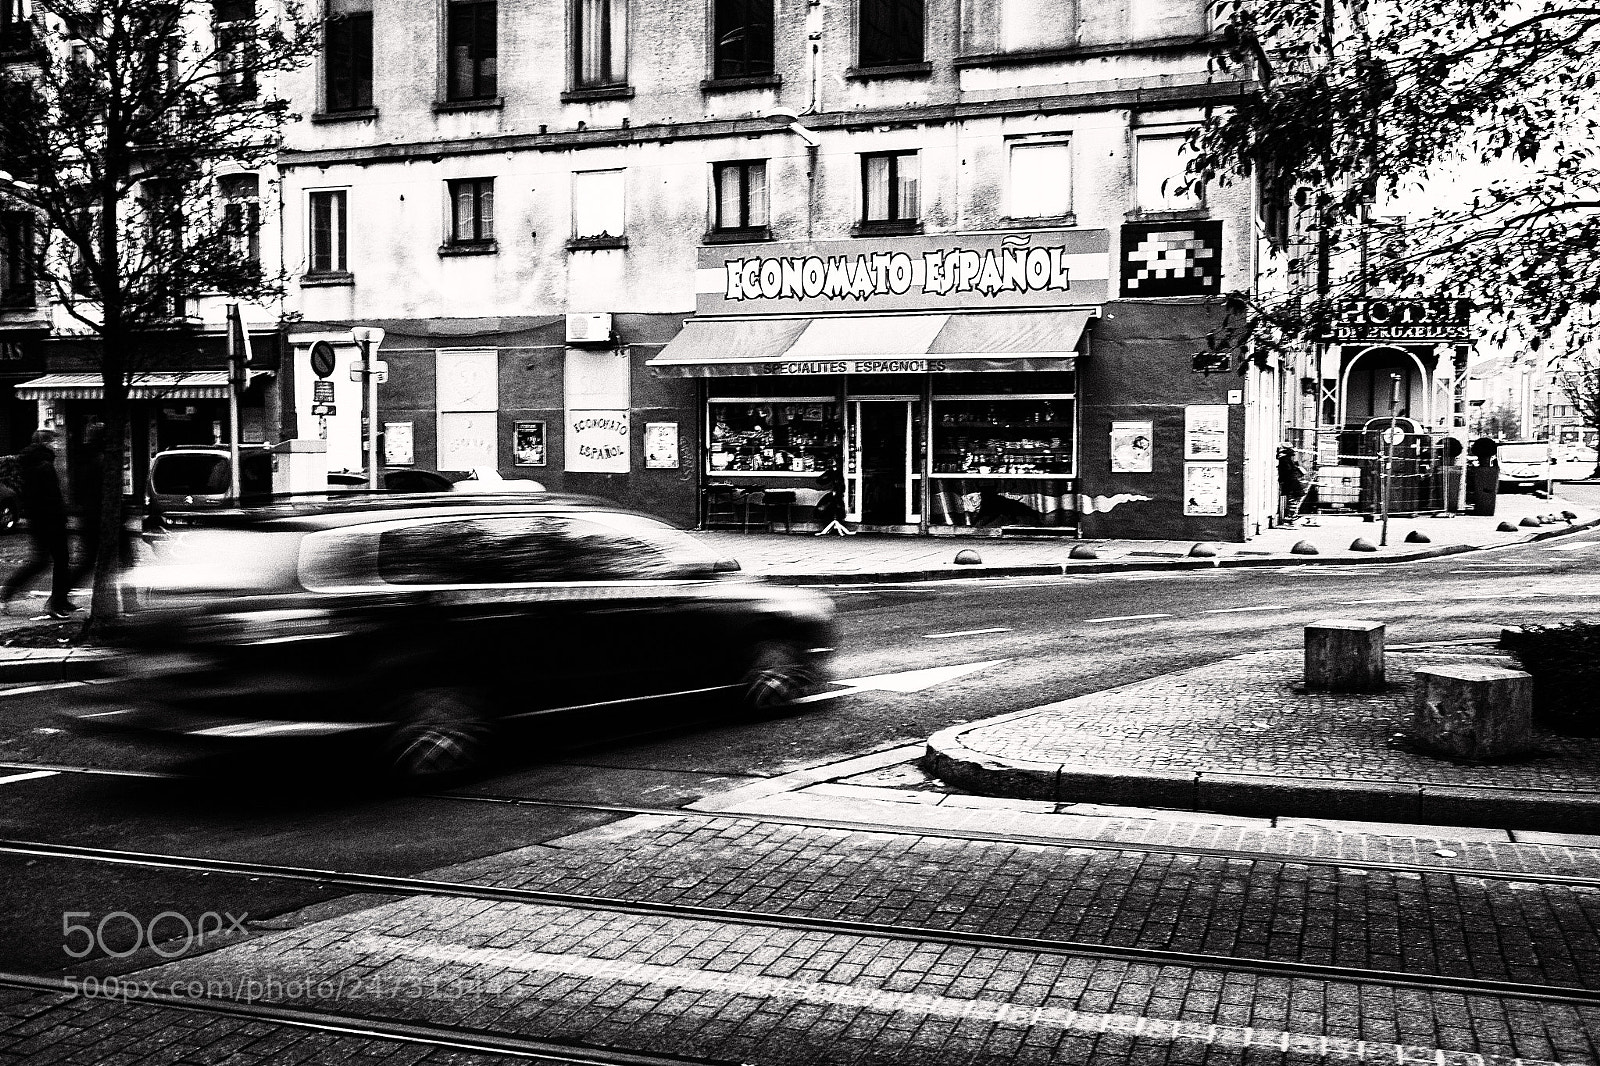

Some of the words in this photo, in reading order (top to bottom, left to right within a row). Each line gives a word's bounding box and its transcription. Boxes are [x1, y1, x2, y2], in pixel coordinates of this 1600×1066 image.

[724, 251, 914, 302] ECONOMATO
[922, 235, 1070, 297] ESPAÑOL
[763, 361, 848, 374] SPECIALITES
[854, 359, 947, 373] ESPAGNOLES
[573, 418, 628, 436] ECONOMATO
